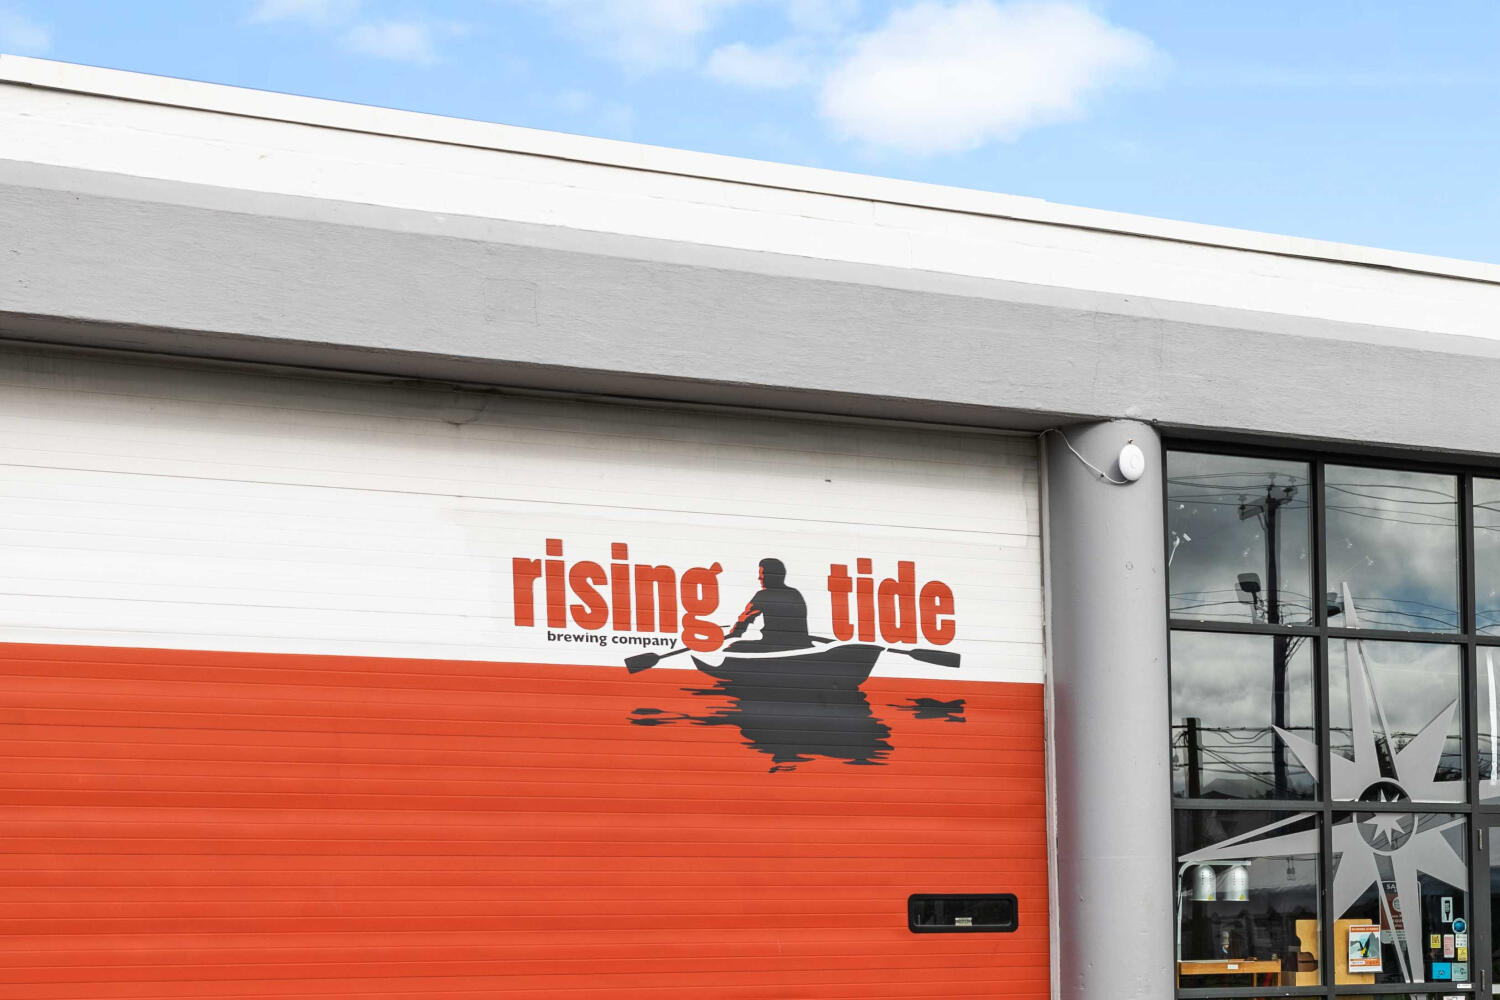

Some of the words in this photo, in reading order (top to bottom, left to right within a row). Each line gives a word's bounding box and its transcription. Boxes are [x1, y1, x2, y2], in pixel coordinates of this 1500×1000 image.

[512, 538, 725, 652] rising
[827, 557, 956, 646] tide
[547, 630, 608, 647] brewing
[611, 634, 677, 650] company
